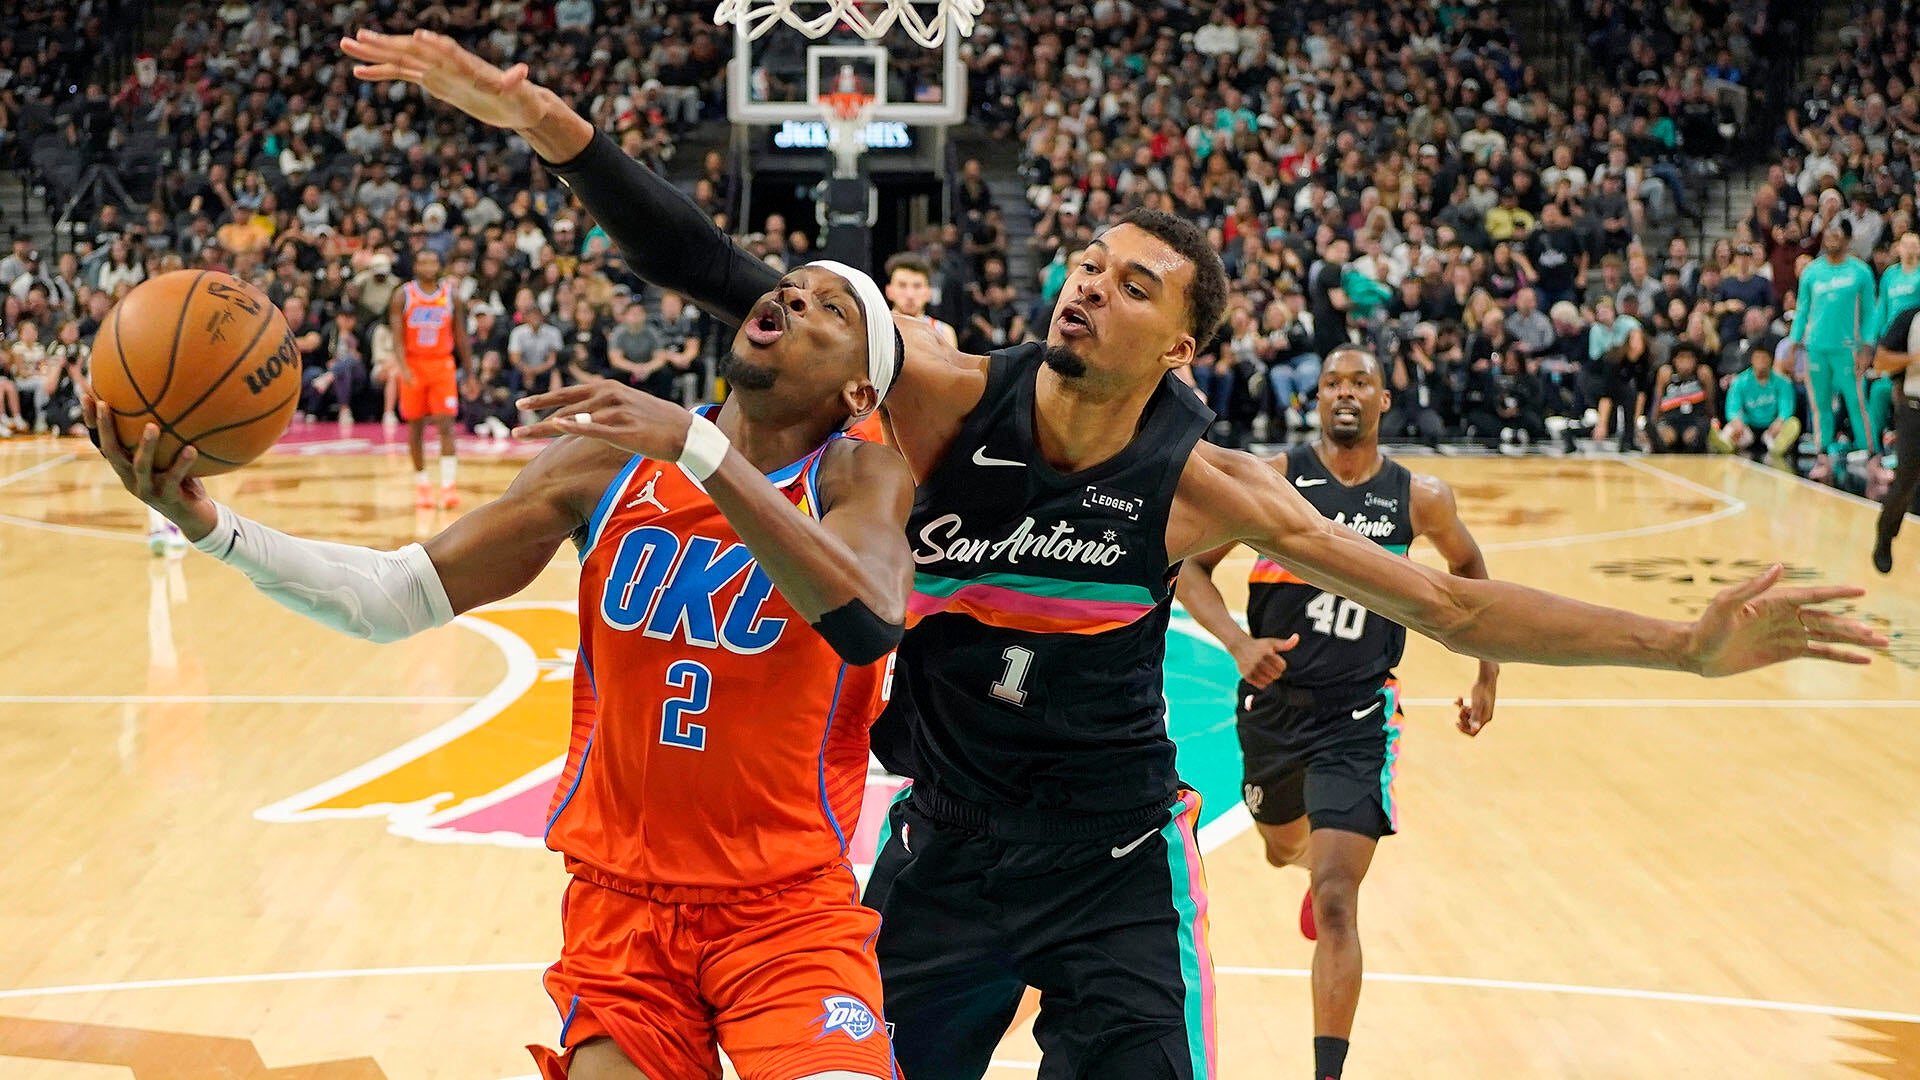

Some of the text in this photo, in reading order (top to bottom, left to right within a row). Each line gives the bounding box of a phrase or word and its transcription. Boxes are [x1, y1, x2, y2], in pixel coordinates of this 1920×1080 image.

[1091, 491, 1134, 514] LEDGER
[911, 513, 1127, 567] San Antonio
[600, 525, 789, 656] OKC
[1305, 591, 1368, 641] 40
[659, 659, 713, 752] 2
[988, 645, 1035, 708] 1
